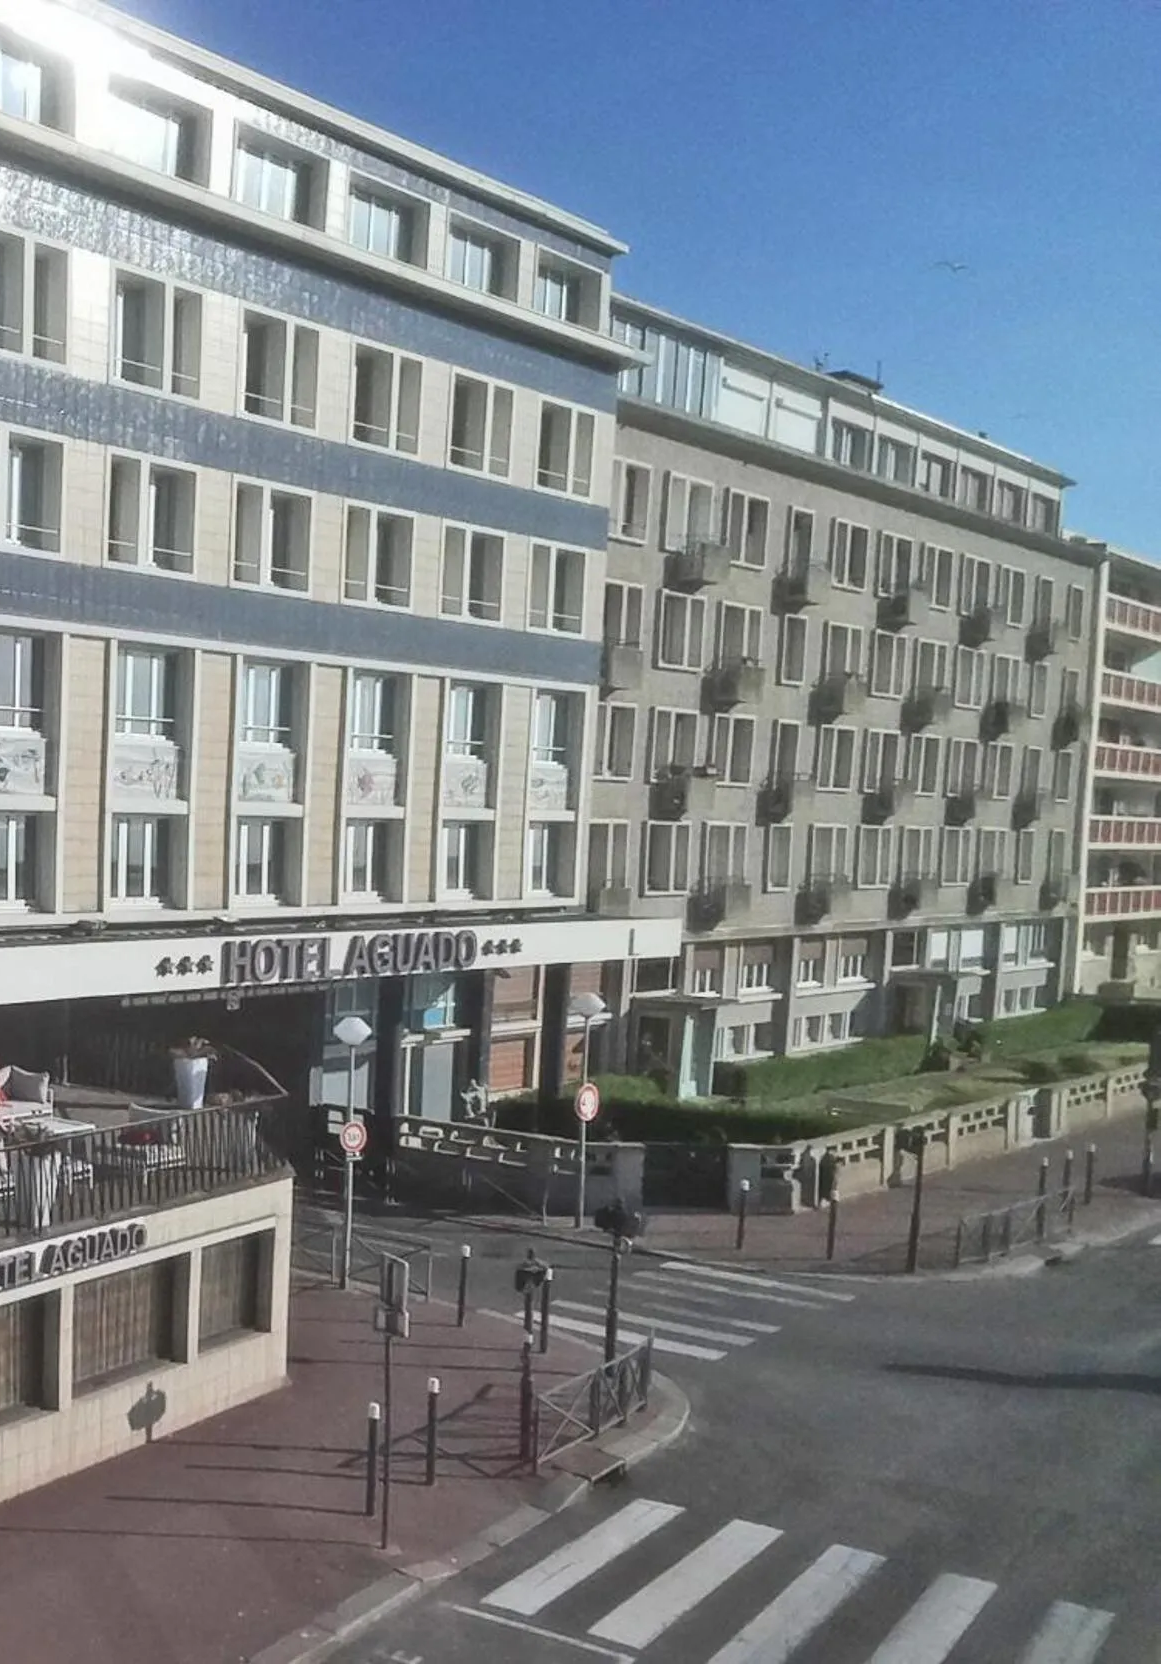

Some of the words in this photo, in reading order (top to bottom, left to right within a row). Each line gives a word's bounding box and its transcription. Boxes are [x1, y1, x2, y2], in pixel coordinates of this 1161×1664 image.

[222, 937, 342, 985] HOTEL
[345, 930, 477, 977] AGUADO
[42, 1223, 148, 1276] AGUADO
